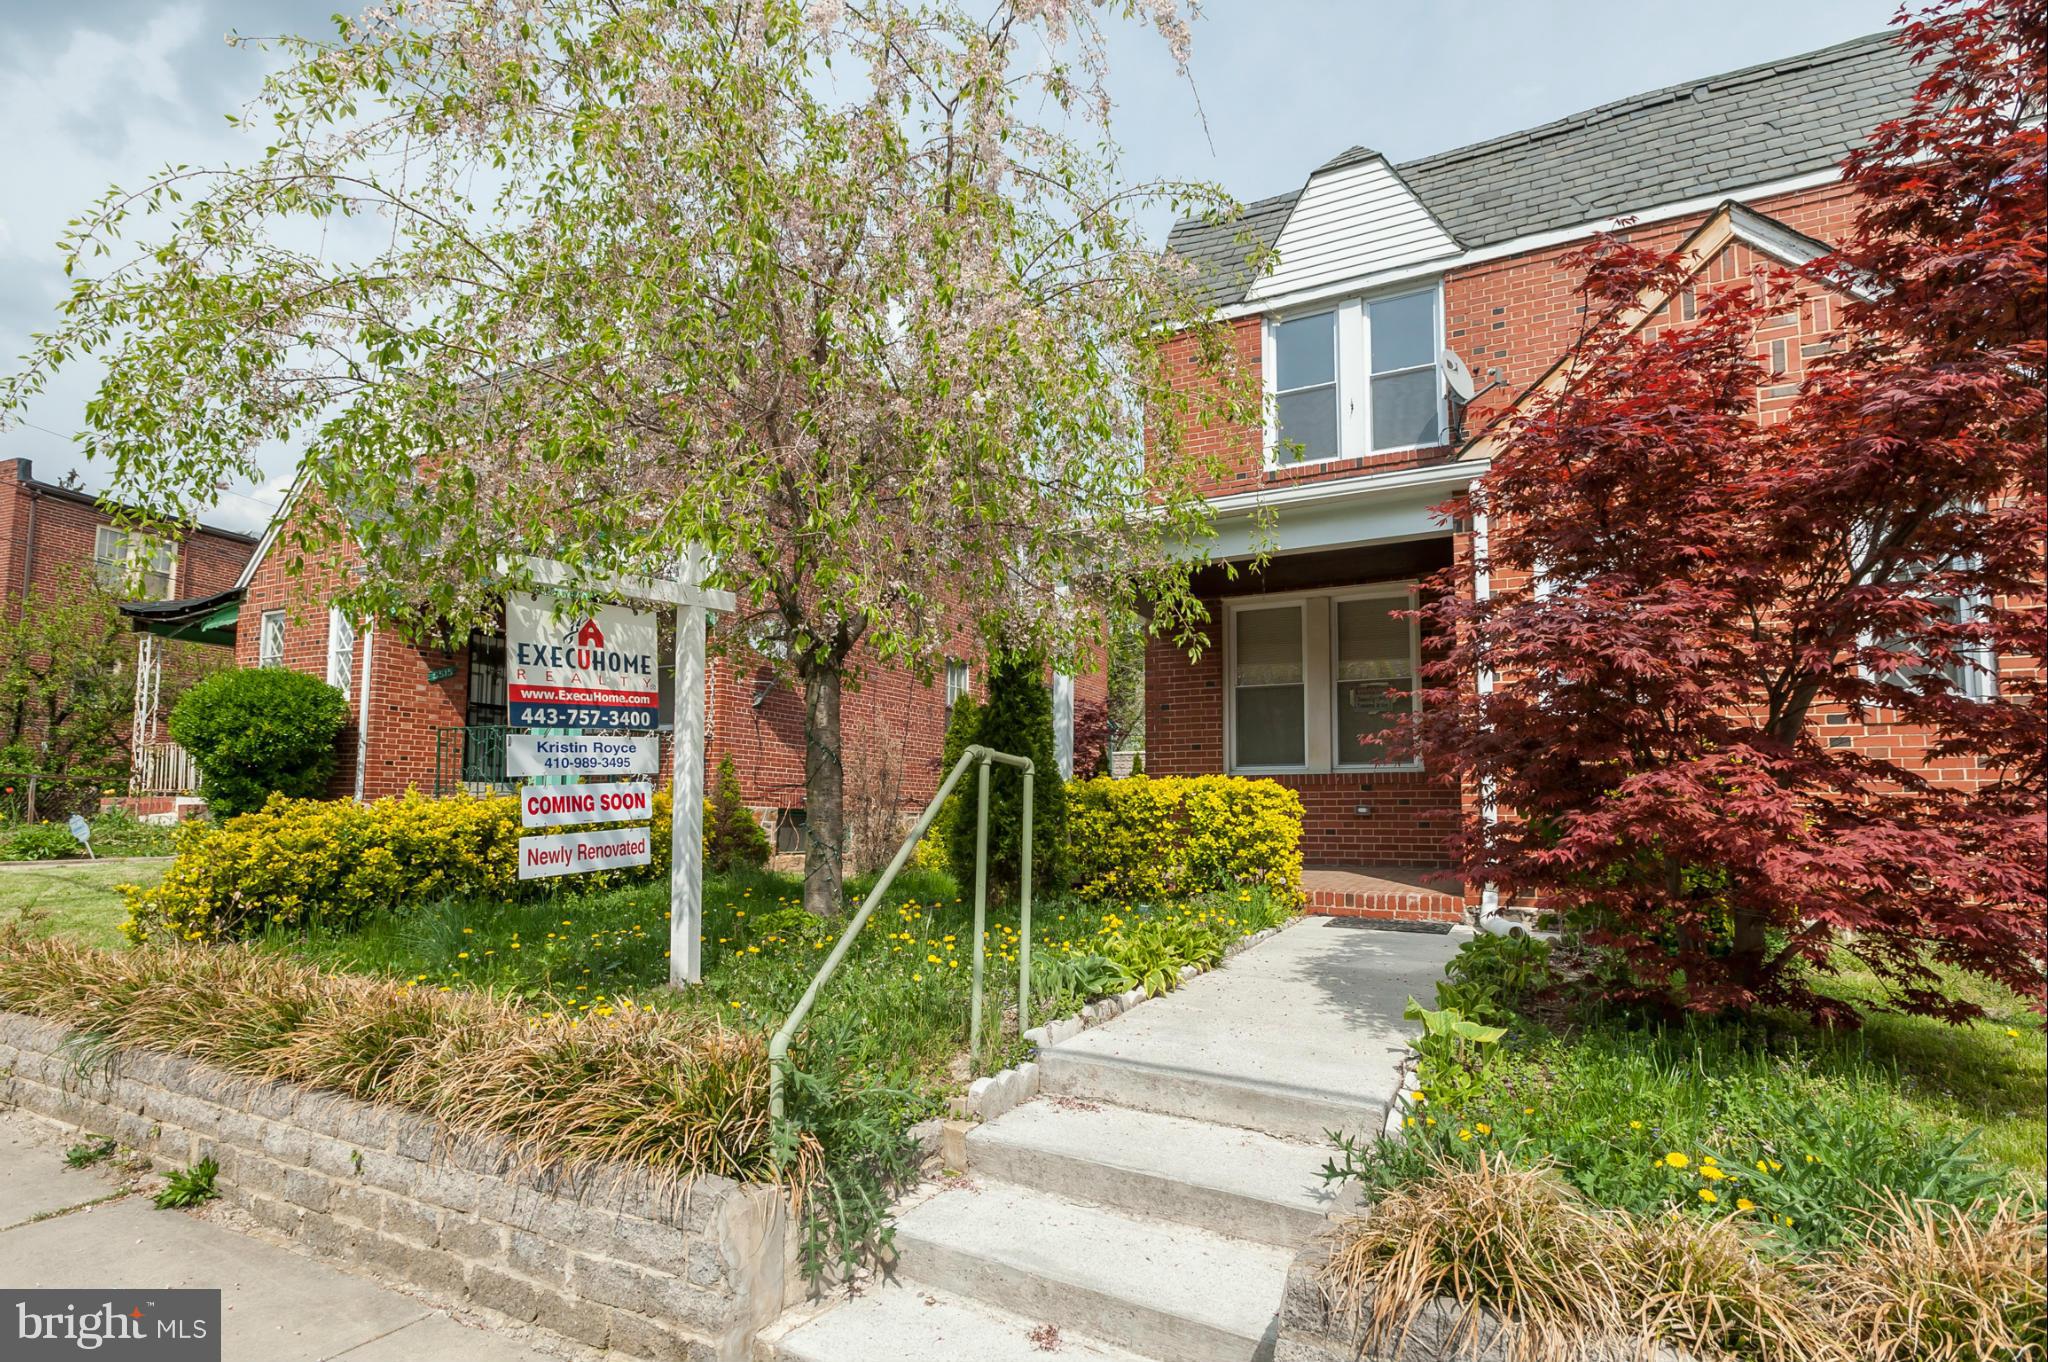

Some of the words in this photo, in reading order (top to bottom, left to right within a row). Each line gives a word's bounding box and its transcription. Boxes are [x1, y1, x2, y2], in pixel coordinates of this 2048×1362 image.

[517, 642, 652, 675] EXECUHOME
[516, 668, 652, 688] REALTY
[520, 689, 651, 705] www.ExecuHome.com
[521, 707, 651, 726] 443-757-3400
[536, 741, 588, 753] Kristin
[593, 742, 637, 756] Royce
[544, 757, 631, 769] 410-989-3495
[527, 794, 595, 815] COMING
[600, 792, 646, 811] SOON
[527, 845, 573, 867] Newly
[577, 838, 645, 861] Renovated
